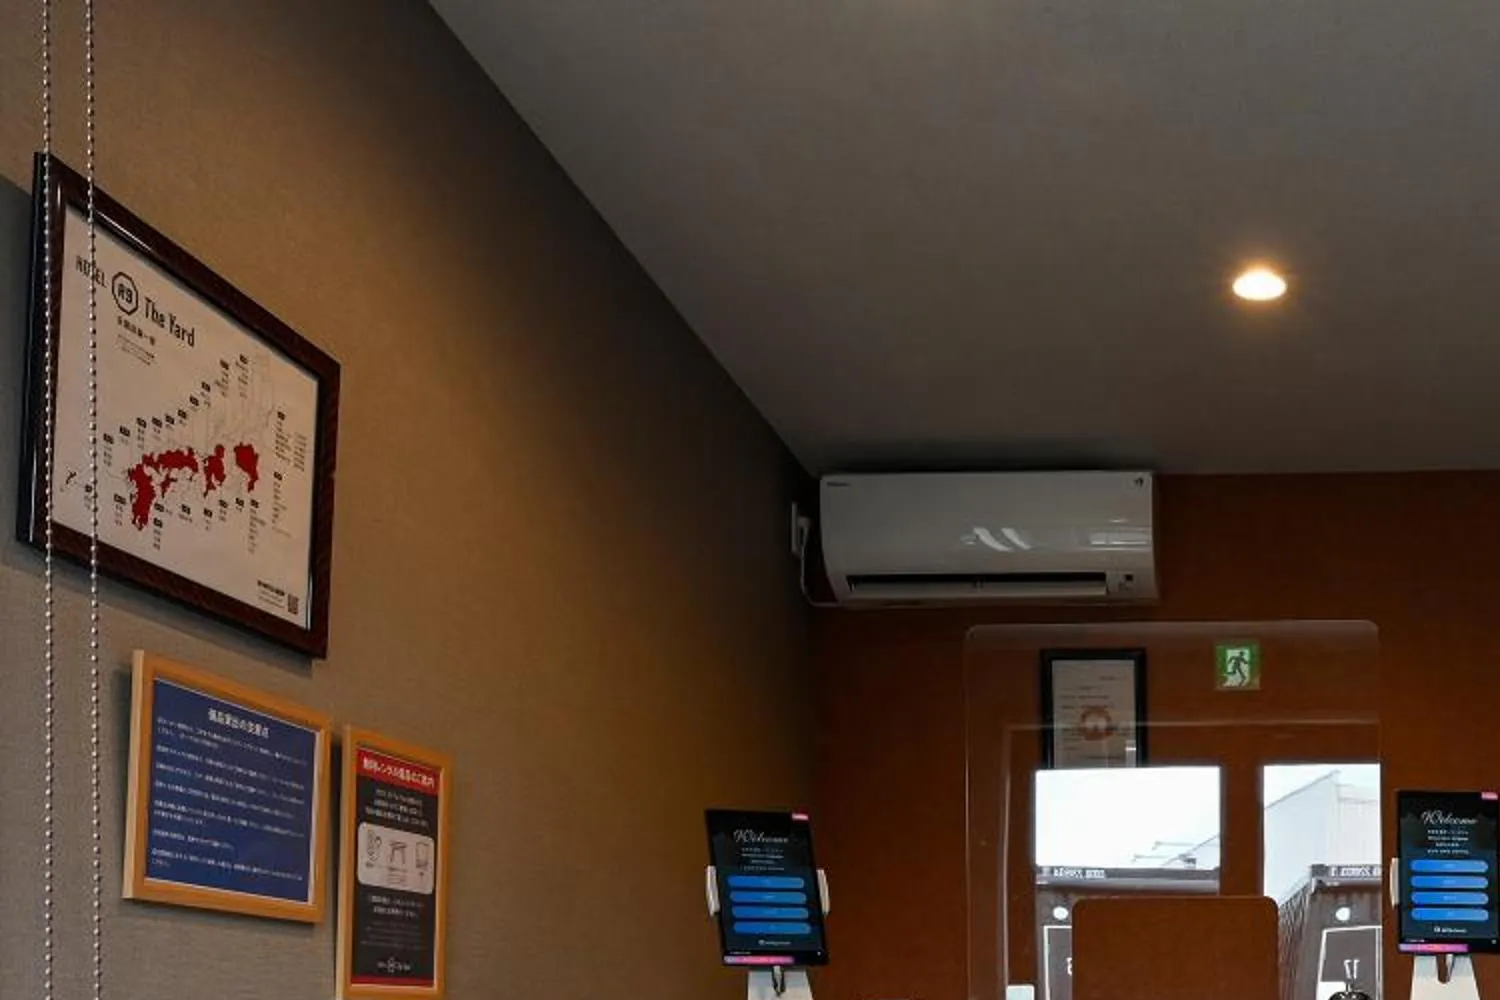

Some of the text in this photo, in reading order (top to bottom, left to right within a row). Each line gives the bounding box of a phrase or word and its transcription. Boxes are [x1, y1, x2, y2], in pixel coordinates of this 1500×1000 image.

[76, 256, 106, 288] HOEL
[145, 297, 165, 328] The
[169, 313, 195, 347] Yard
